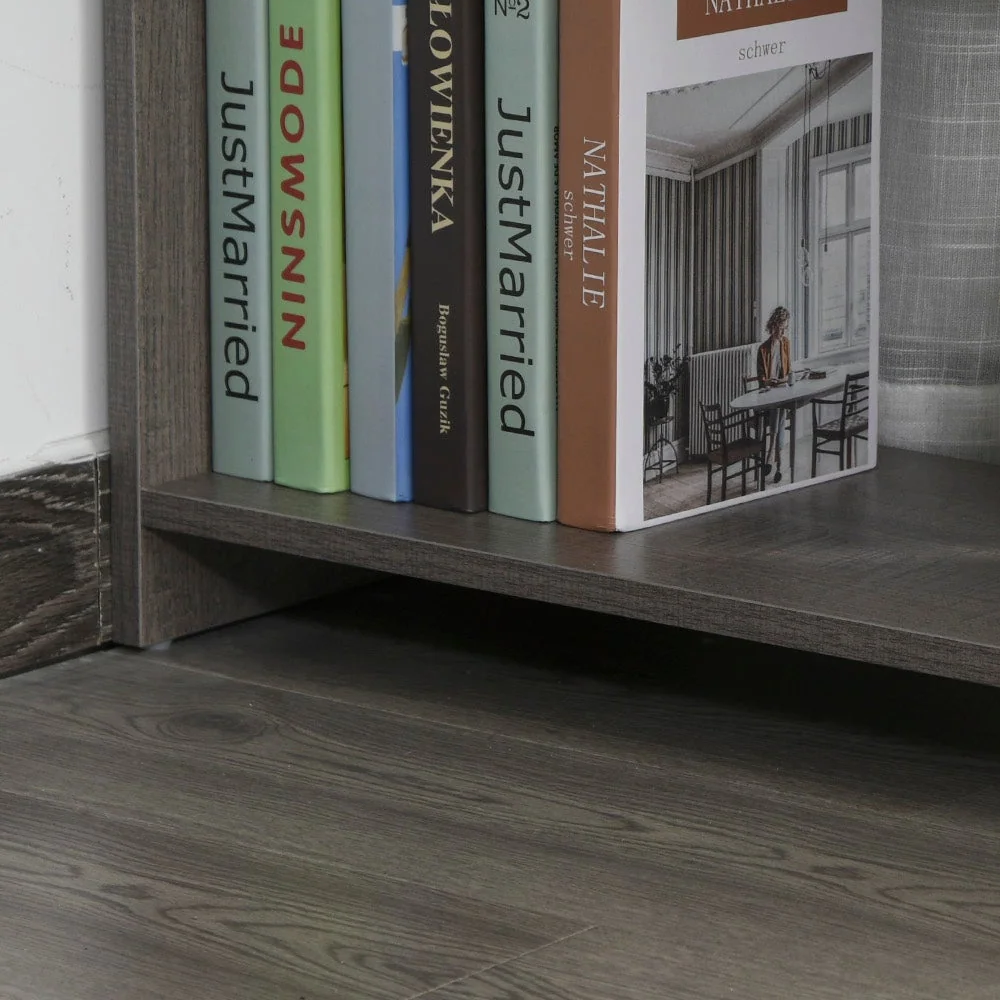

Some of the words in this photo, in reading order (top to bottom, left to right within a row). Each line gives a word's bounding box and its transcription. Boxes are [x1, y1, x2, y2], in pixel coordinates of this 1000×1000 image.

[738, 39, 787, 61] schwer
[279, 24, 305, 351] NINSMODE
[582, 136, 607, 309] NATHALIE
[563, 190, 578, 261] schwer
[438, 385, 451, 434] Guzik
